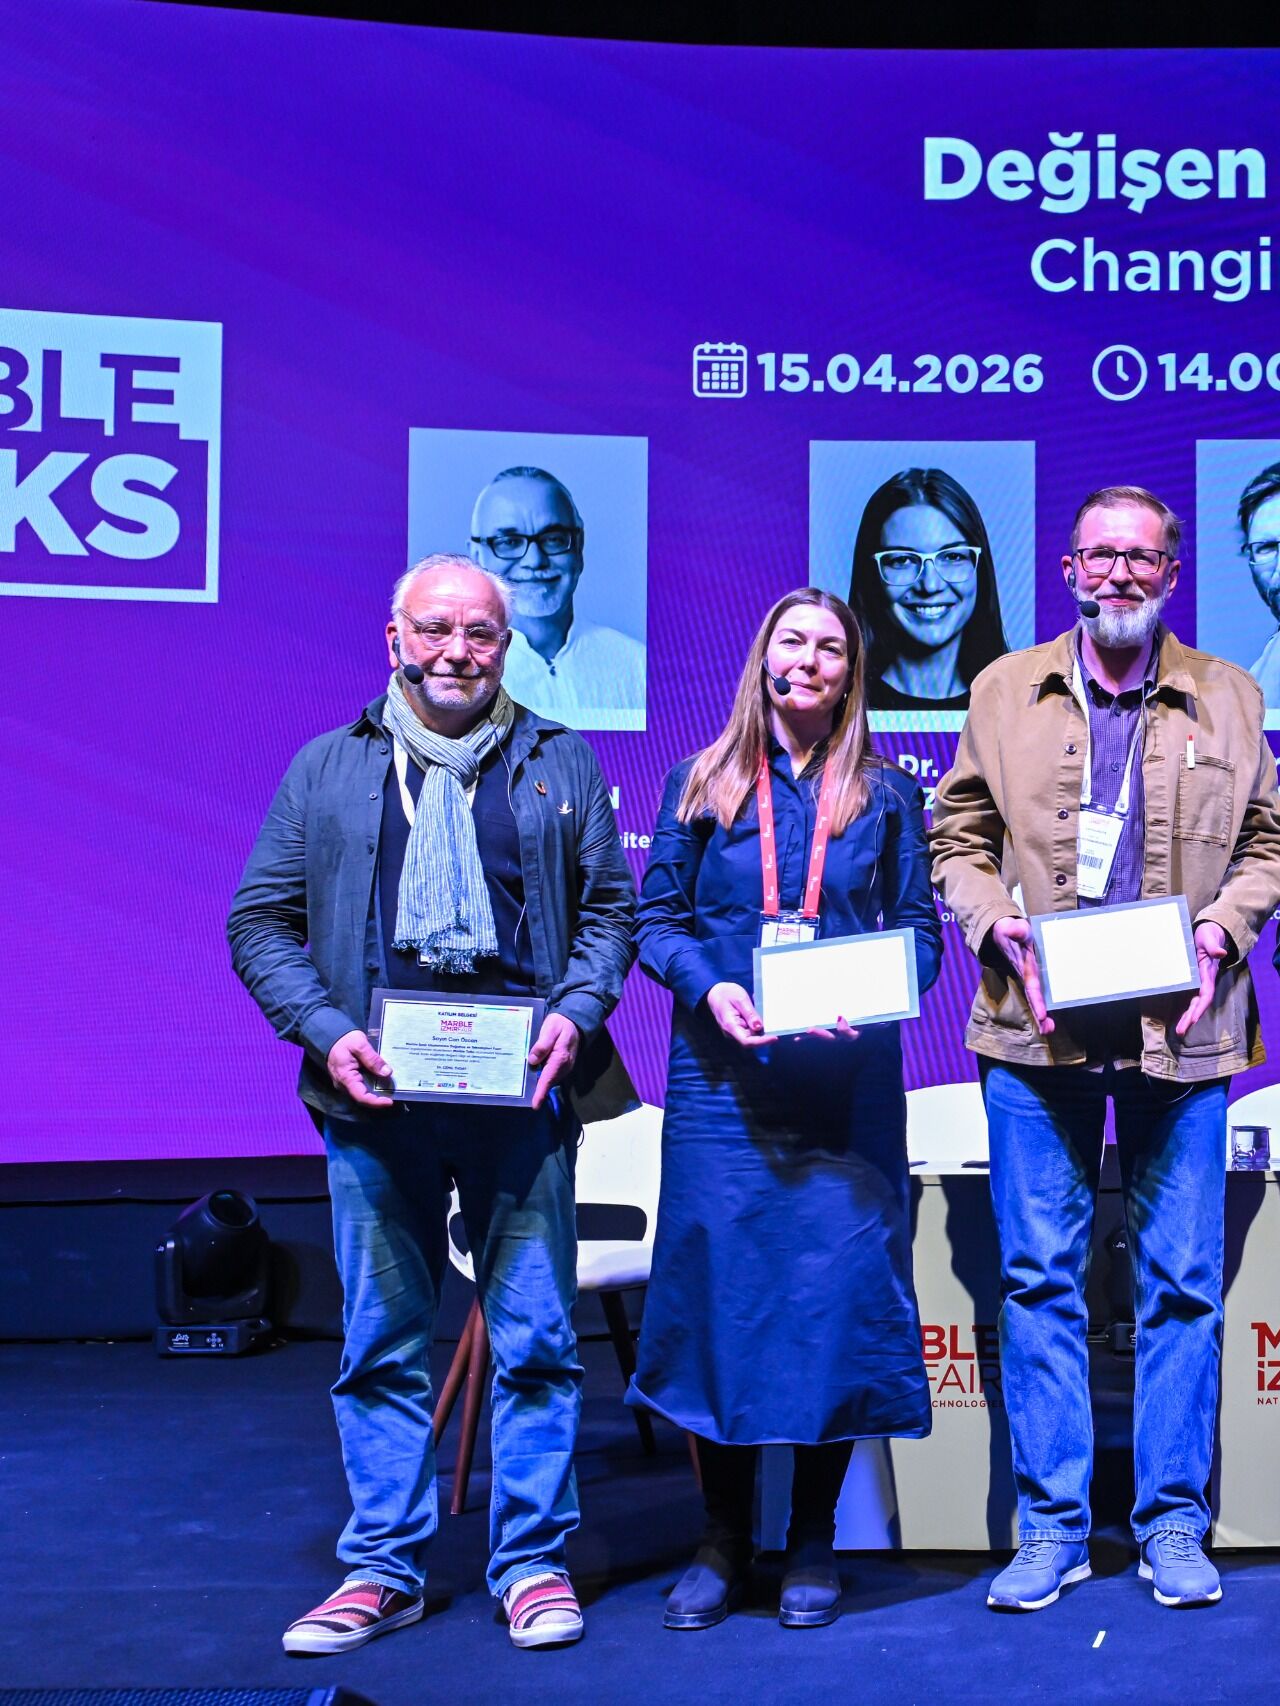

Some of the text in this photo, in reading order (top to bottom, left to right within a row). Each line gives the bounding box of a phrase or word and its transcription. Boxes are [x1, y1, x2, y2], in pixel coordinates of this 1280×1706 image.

[923, 131, 1266, 214] Değişen
[0, 346, 181, 440] BLE
[756, 352, 1044, 394] 15.04.2026
[0, 448, 181, 560] KS
[898, 754, 939, 777] Dr.
[440, 1020, 473, 1028] MARBLE
[920, 1324, 999, 1361] BLE
